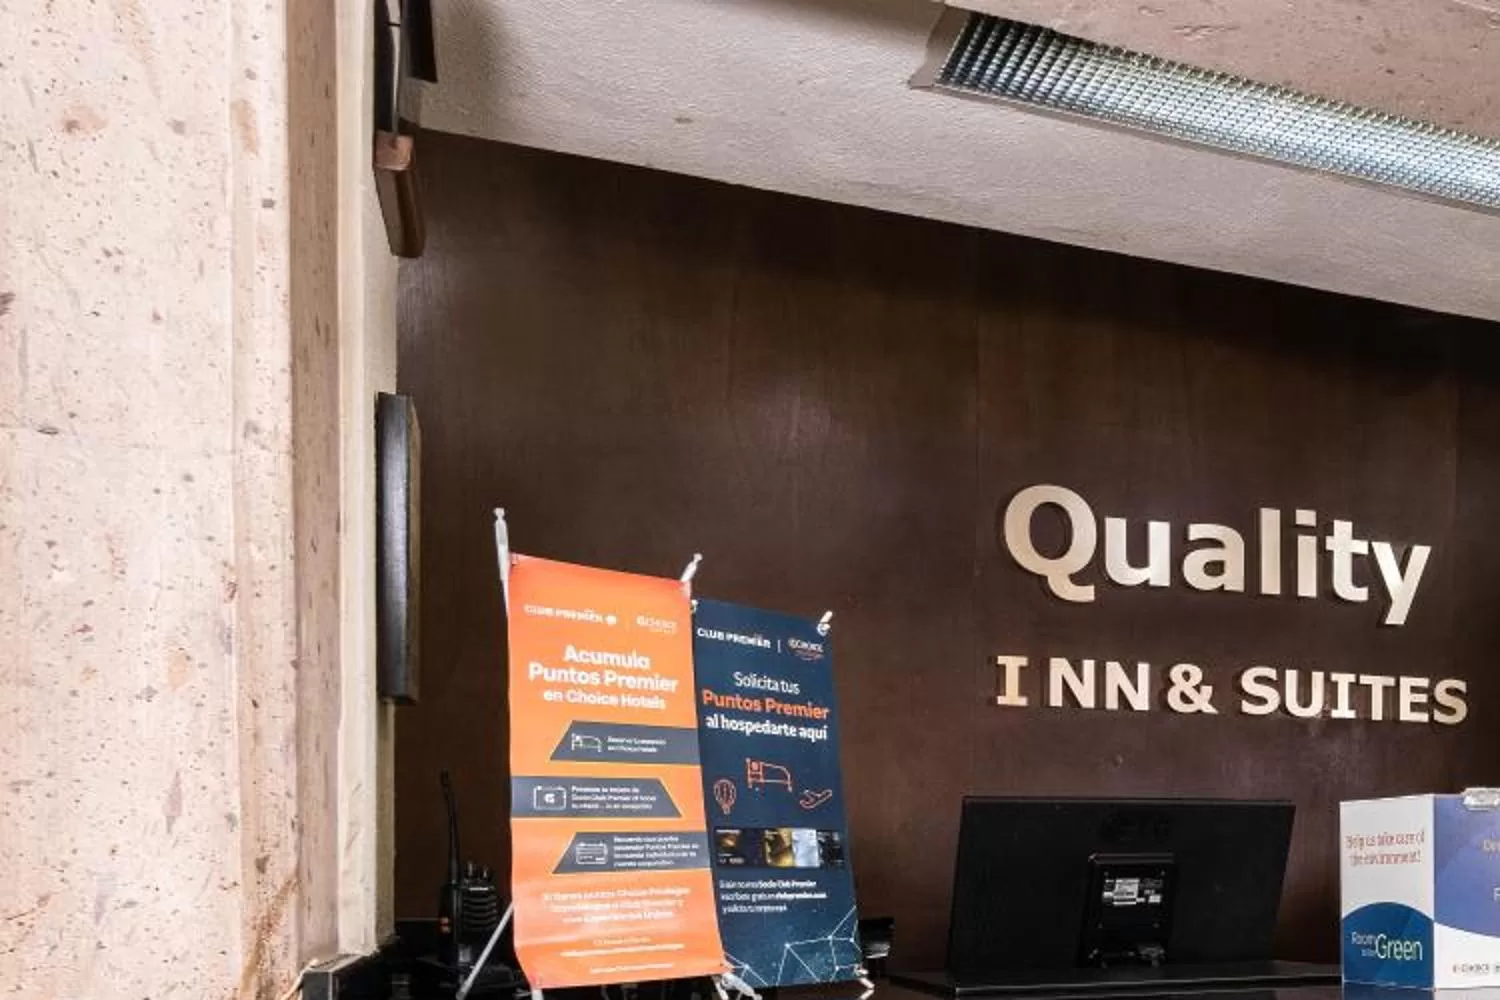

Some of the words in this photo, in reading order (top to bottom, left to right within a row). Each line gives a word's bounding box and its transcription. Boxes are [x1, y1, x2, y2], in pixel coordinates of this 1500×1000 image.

[1003, 484, 1432, 625] Quality
[697, 627, 725, 641] CLUB
[564, 644, 651, 670] Acumula
[528, 662, 601, 686] Puntos
[603, 669, 680, 693] Premier
[732, 671, 779, 692] Solicita
[780, 680, 801, 695] tus
[997, 655, 1150, 711] INN
[1166, 663, 1219, 714] &
[1240, 666, 1468, 724] SUITES
[543, 689, 563, 702] en
[566, 689, 619, 706] Choice
[621, 692, 667, 710] Hotels
[702, 689, 763, 712] Puntos
[765, 697, 830, 720] Premier
[706, 714, 718, 729] al
[720, 714, 797, 737] hospedarte
[1351, 931, 1377, 945] Room
[1375, 933, 1424, 961] Green
